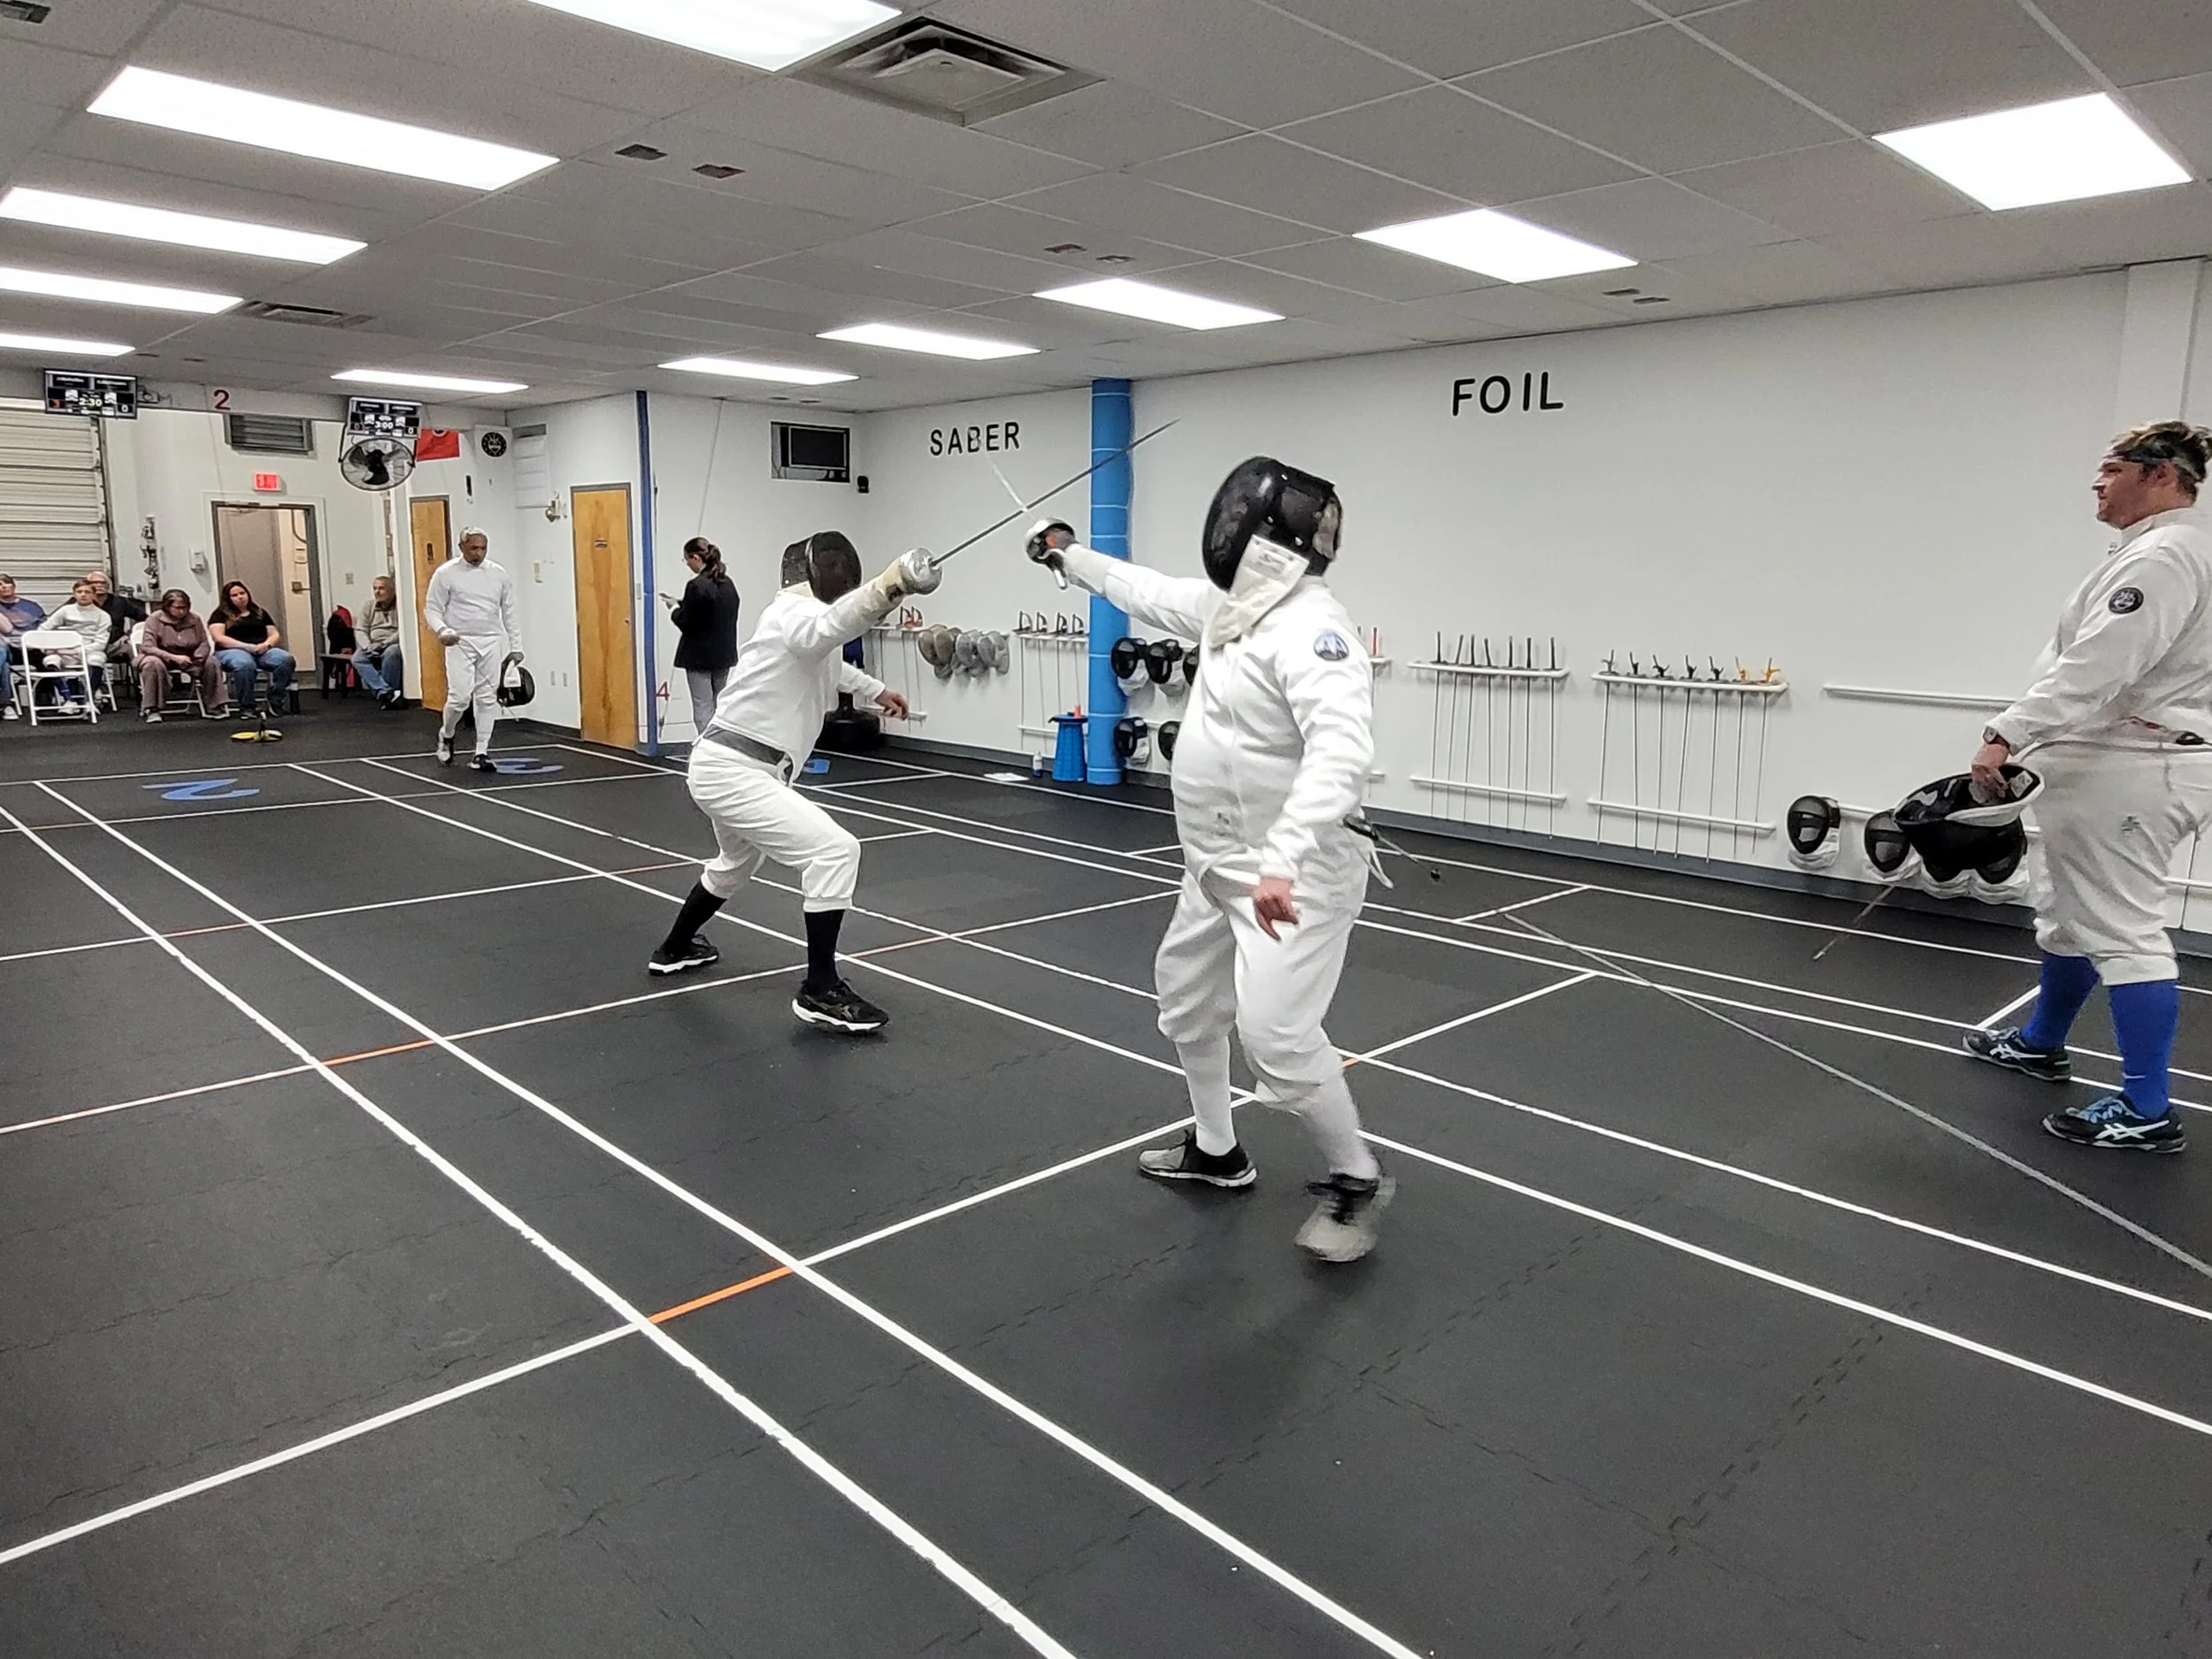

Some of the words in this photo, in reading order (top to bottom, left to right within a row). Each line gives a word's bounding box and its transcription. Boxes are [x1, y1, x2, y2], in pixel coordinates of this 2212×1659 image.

[79, 397, 103, 407] 2:30
[213, 389, 231, 410] 2
[1452, 371, 1564, 417] FOIL
[121, 404, 129, 413] 0
[930, 421, 1020, 456] SABER
[656, 681, 670, 701] 4
